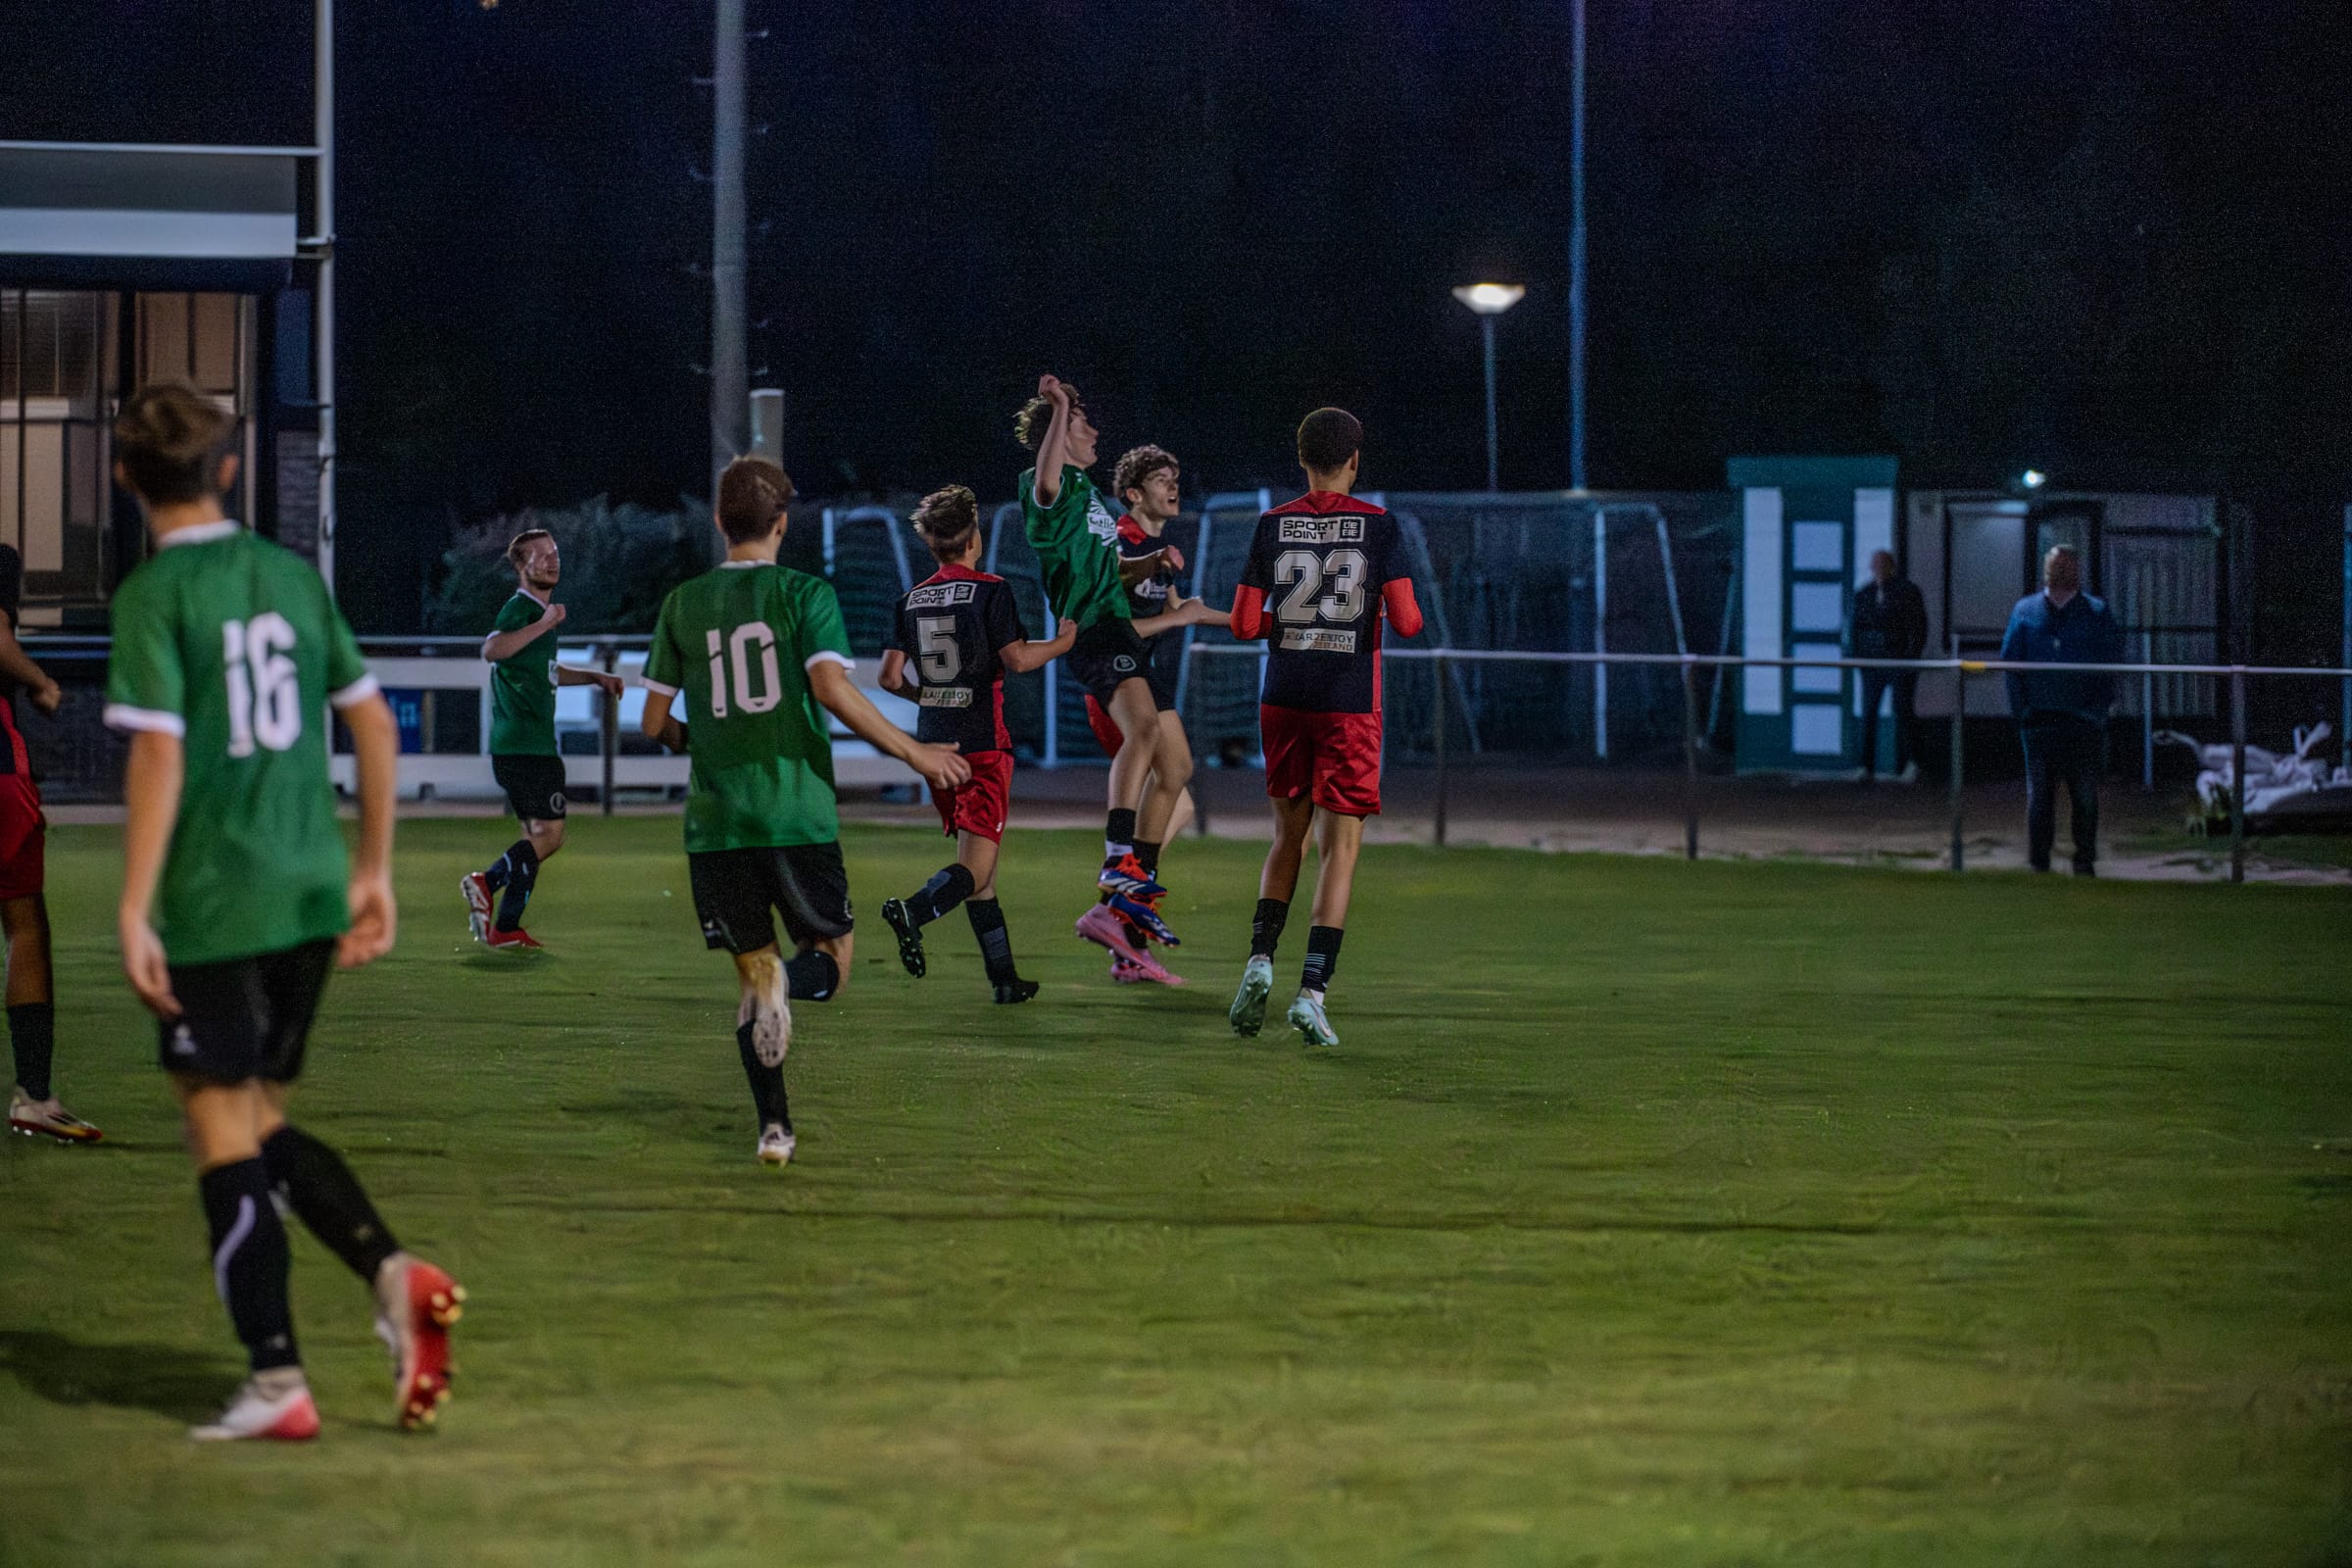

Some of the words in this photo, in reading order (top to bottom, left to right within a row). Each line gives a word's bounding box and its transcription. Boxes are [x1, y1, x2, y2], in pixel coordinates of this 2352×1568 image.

[1283, 520, 1338, 531] SPORT
[1283, 530, 1327, 540] POINT
[909, 597, 945, 606] POINT
[911, 586, 955, 600] SPORT
[1274, 549, 1368, 623] 23
[916, 614, 961, 683] 5
[221, 611, 302, 759] 16
[707, 620, 782, 719] 10
